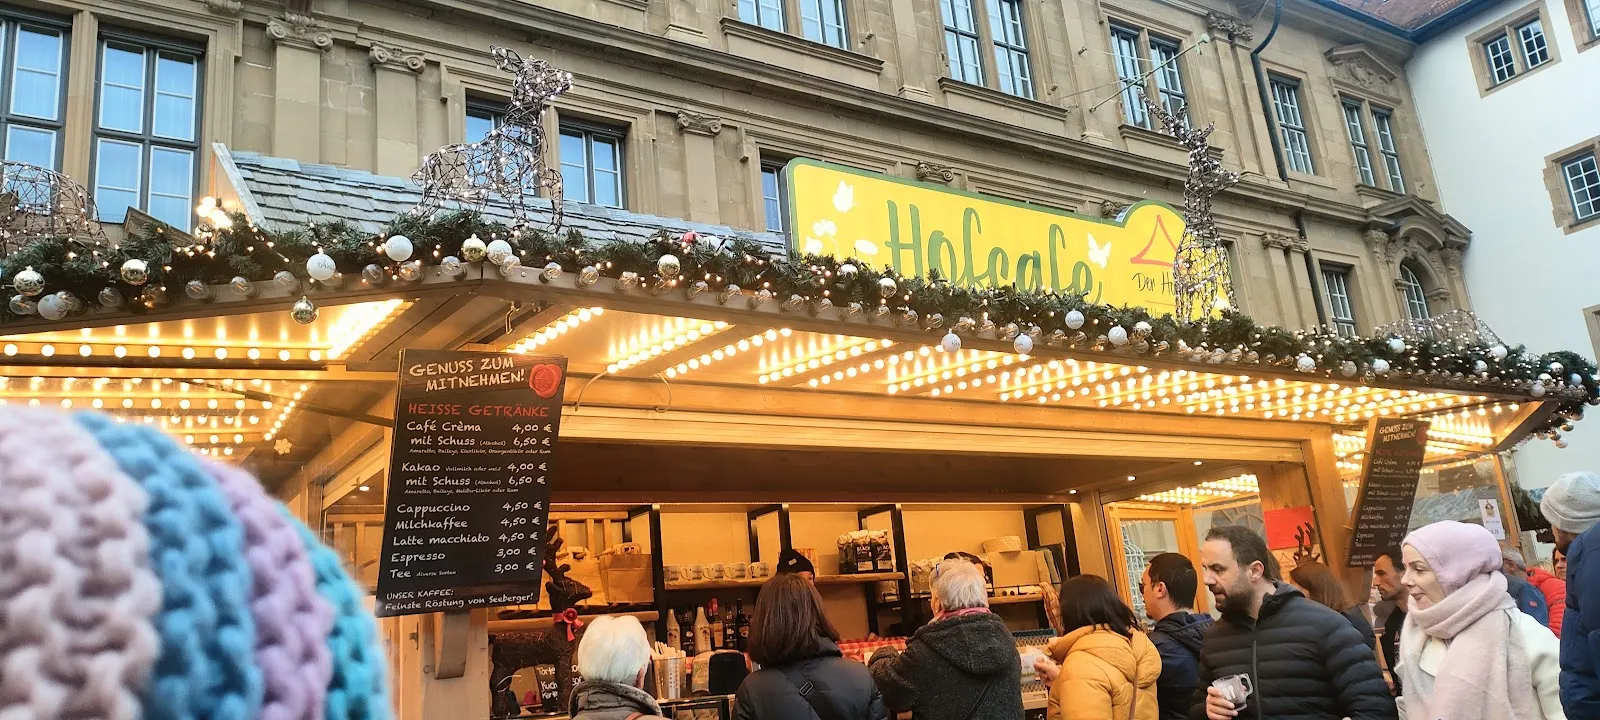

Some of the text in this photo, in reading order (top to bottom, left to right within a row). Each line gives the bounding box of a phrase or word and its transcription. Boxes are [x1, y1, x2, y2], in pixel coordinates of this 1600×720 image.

[408, 356, 514, 377] GENUSS ZUM
[425, 368, 526, 392] MITNEHMEN!
[408, 402, 549, 417] HEISSE GETRÄNKE
[406, 419, 553, 434] Café Crèma 4,00 €
[410, 435, 433, 446] mit
[438, 436, 476, 446] Schuss
[513, 437, 537, 448] 6,50
[542, 437, 551, 446] €
[401, 462, 441, 472] Kakao
[507, 462, 534, 474] 4,00
[538, 462, 548, 472] €
[405, 476, 428, 486] mit
[433, 476, 470, 486] Schuss
[508, 476, 532, 487] 6,50
[537, 476, 546, 485] €
[396, 501, 542, 518] Cappuccino 4,50 €
[395, 516, 541, 531] Milchkaffee 4,50 €
[393, 531, 539, 546] Latte macchiato 4,50 €
[391, 546, 537, 567] Espresso 3,00 €
[389, 569, 412, 579] Tee
[494, 563, 519, 574] 3,00
[526, 562, 535, 571] €
[385, 601, 421, 611] Feinste
[425, 598, 464, 609] Röstung
[489, 592, 534, 604] Seeberger!
[386, 589, 454, 600] UNSER KAFFEE:
[540, 680, 558, 690] Kuch
